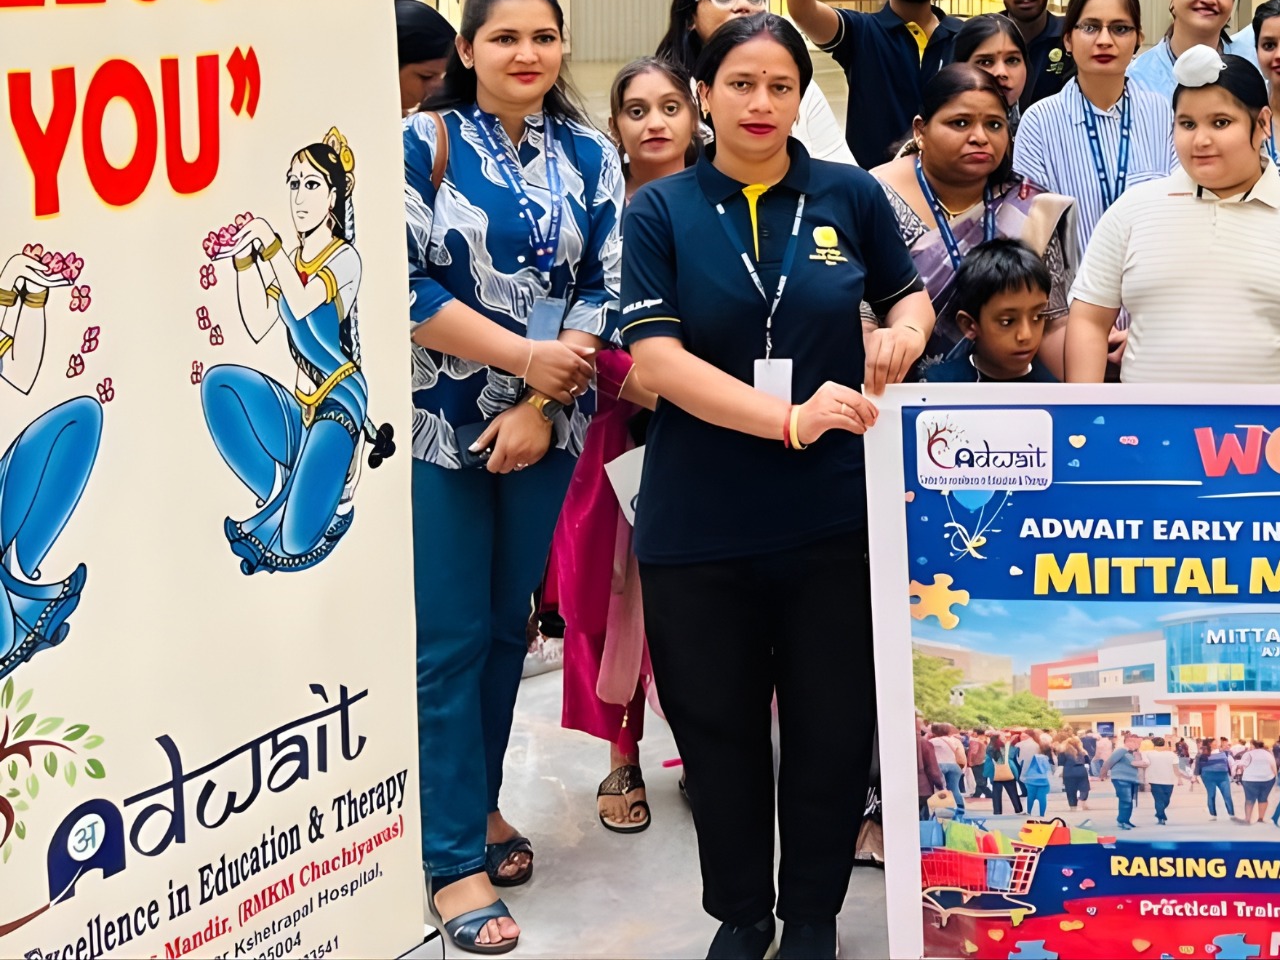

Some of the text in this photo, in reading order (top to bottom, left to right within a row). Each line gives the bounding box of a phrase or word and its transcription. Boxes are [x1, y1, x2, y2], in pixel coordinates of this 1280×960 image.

[1019, 517, 1144, 540] ADWAIT
[1153, 518, 1244, 542] EARLY
[1033, 552, 1239, 595] MITTAL
[47, 683, 369, 906] Adwait
[168, 879, 192, 921] in
[198, 823, 302, 906] Education
[308, 805, 325, 844] &
[331, 769, 408, 833] Therapy
[1110, 855, 1227, 879] RAISING
[238, 873, 296, 928] (RMKM
[1139, 899, 1228, 917] Practical
[234, 897, 314, 958] Kshetrapal
